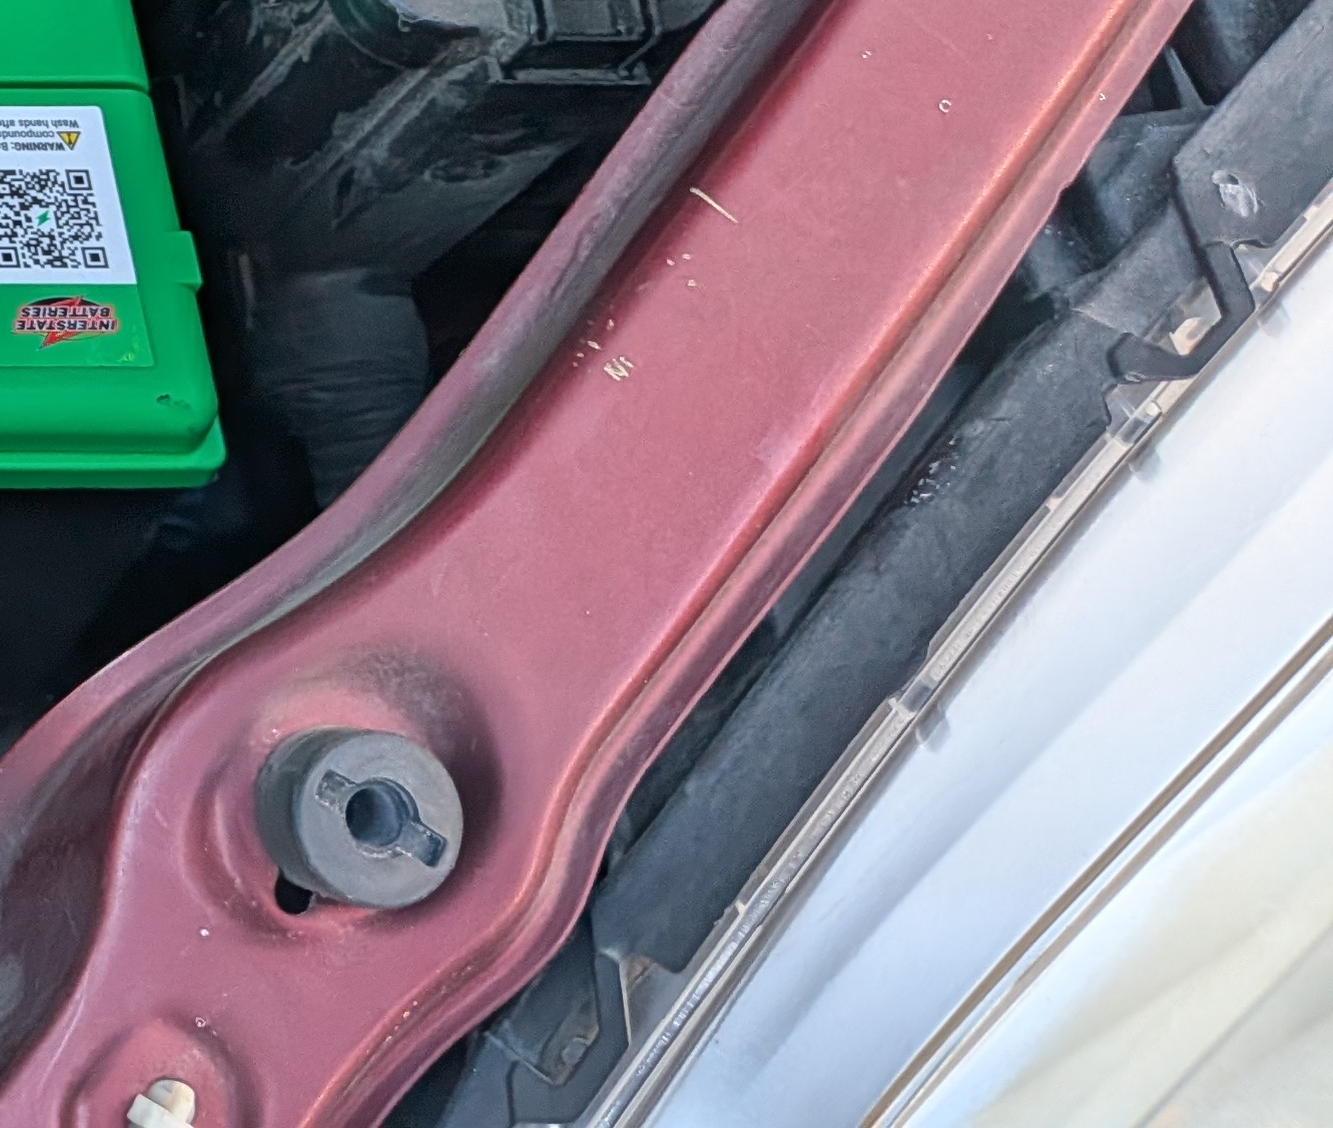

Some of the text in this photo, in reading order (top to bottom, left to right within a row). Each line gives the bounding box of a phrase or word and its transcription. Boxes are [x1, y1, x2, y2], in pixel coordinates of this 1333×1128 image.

[18, 119, 48, 128] hands
[52, 119, 79, 128] Wash
[11, 142, 65, 151] WARNING:
[20, 306, 111, 318] BATTERIES
[16, 318, 116, 332] INTERSTATE
